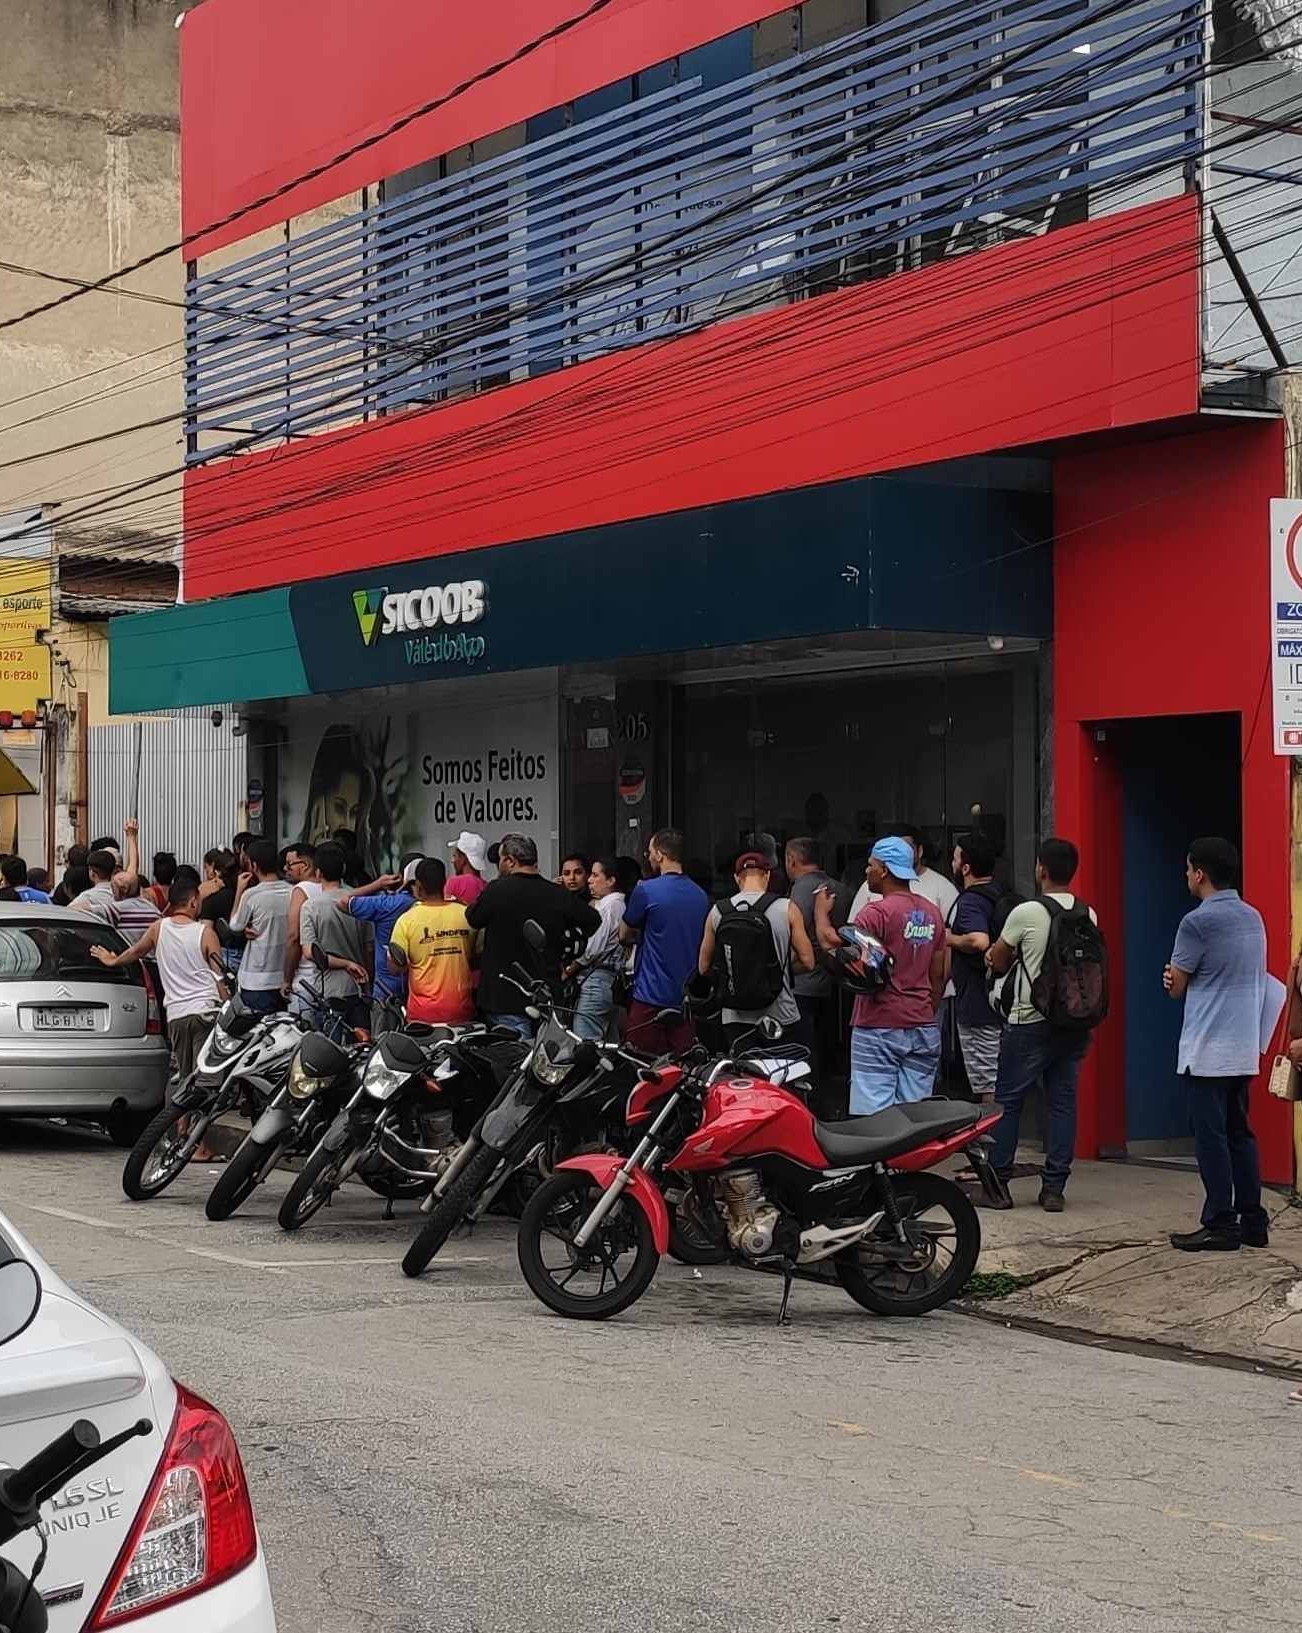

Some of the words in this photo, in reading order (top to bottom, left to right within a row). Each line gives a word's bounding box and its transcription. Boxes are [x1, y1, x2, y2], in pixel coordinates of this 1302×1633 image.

[3, 596, 43, 612] esporte
[382, 580, 485, 634] SICOOB
[422, 753, 482, 786] Somos
[488, 748, 545, 781] Feitos
[434, 795, 456, 823] de
[461, 790, 539, 823] Valores.
